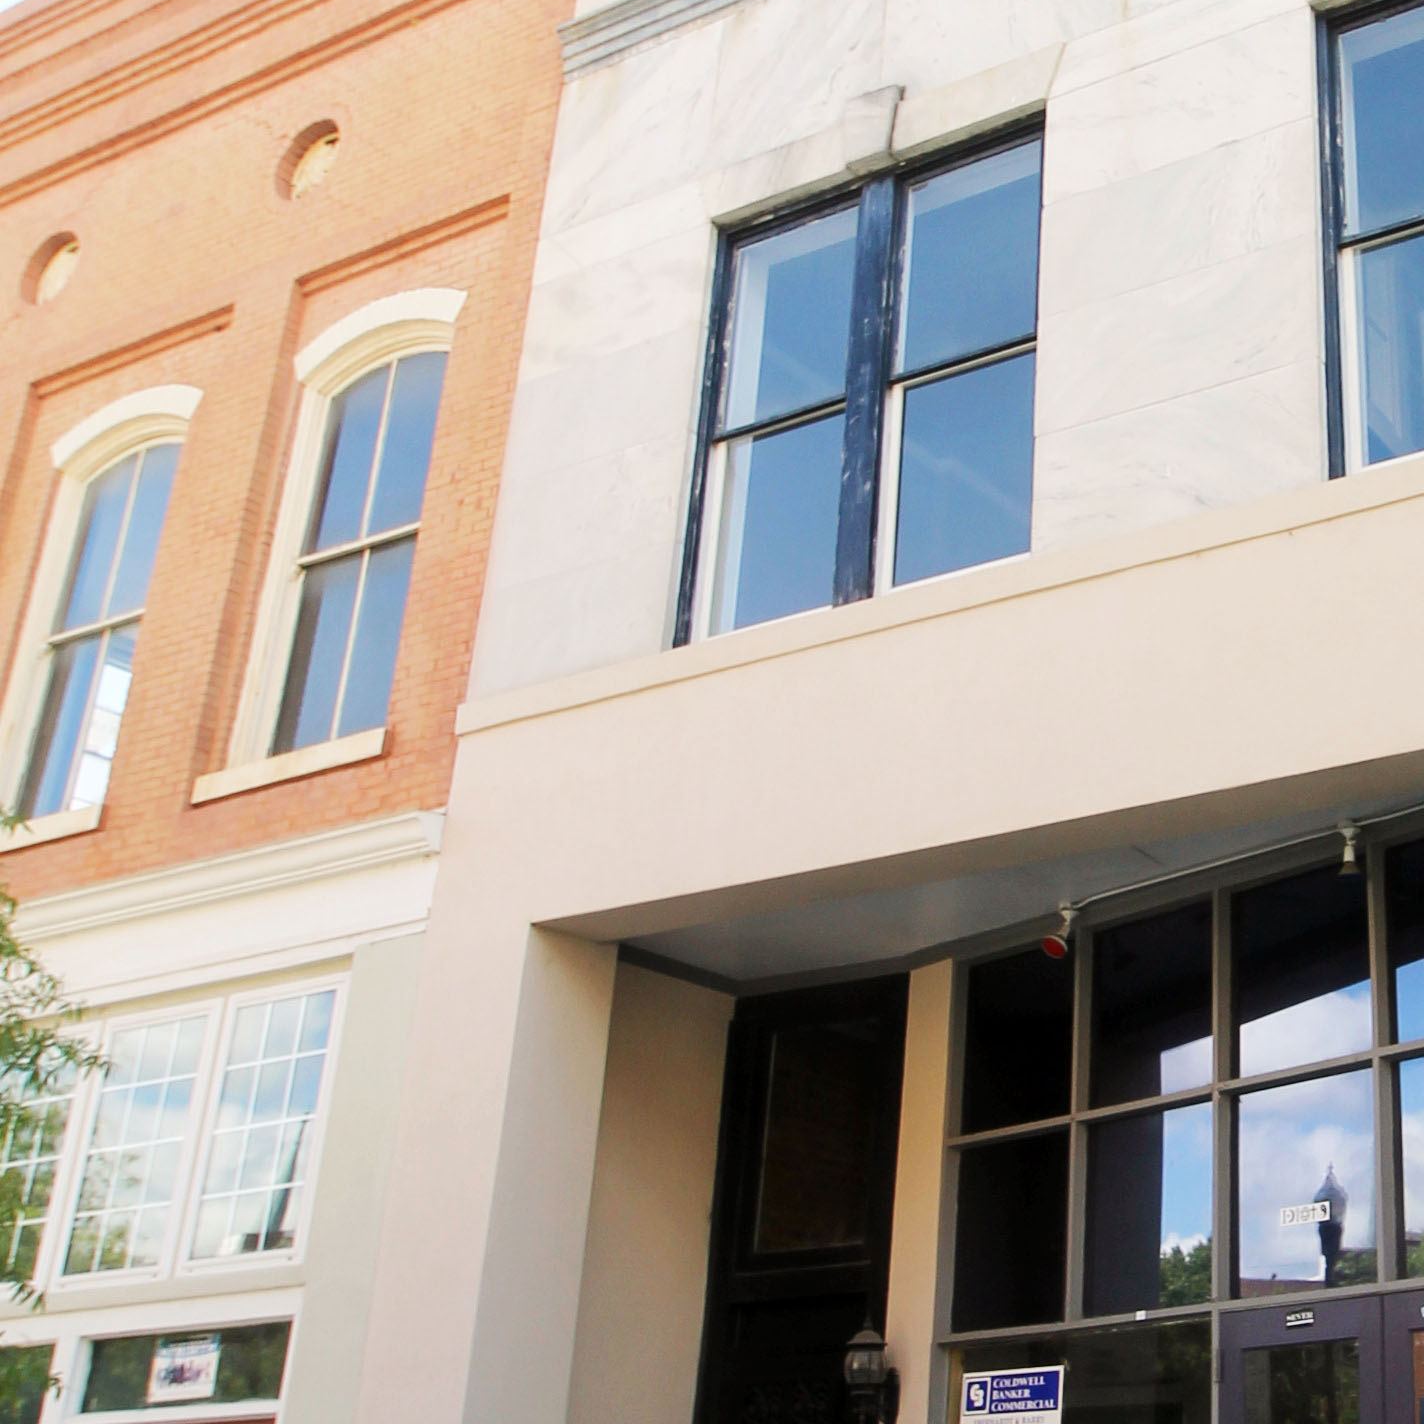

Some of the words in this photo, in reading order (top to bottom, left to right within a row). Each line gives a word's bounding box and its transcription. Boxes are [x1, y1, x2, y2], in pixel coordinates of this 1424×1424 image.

[993, 1376, 1045, 1388] COLDWELL
[992, 1389, 1031, 1400] BANKER
[991, 1399, 1056, 1412] COMMERCIAL
